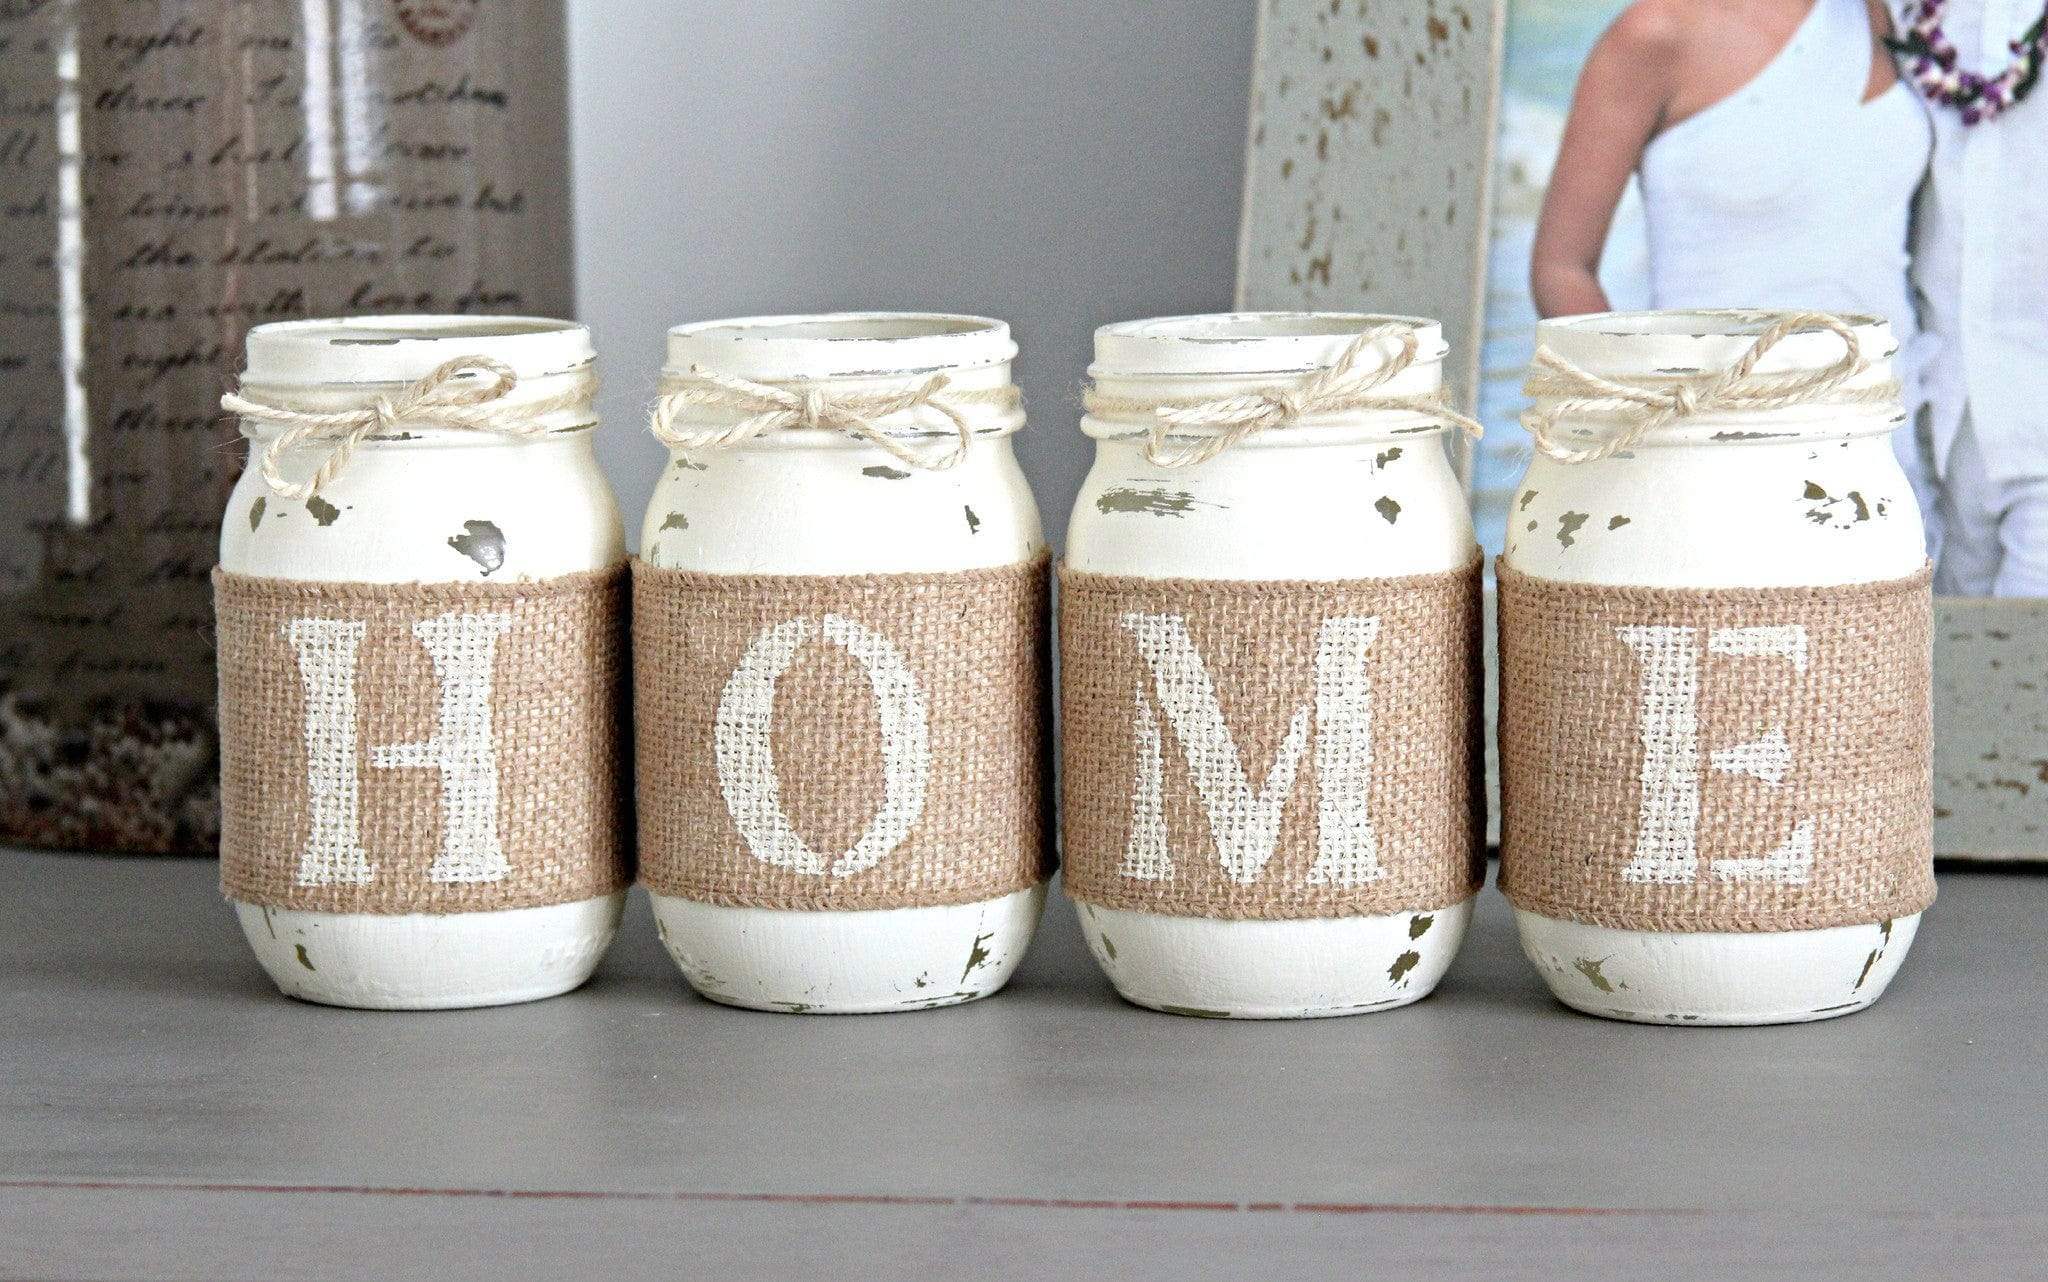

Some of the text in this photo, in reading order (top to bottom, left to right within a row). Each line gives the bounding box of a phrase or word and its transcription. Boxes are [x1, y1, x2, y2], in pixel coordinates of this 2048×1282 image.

[283, 612, 511, 886] H
[715, 613, 930, 877] O
[1120, 612, 1388, 886] M
[1614, 624, 1814, 886] E
